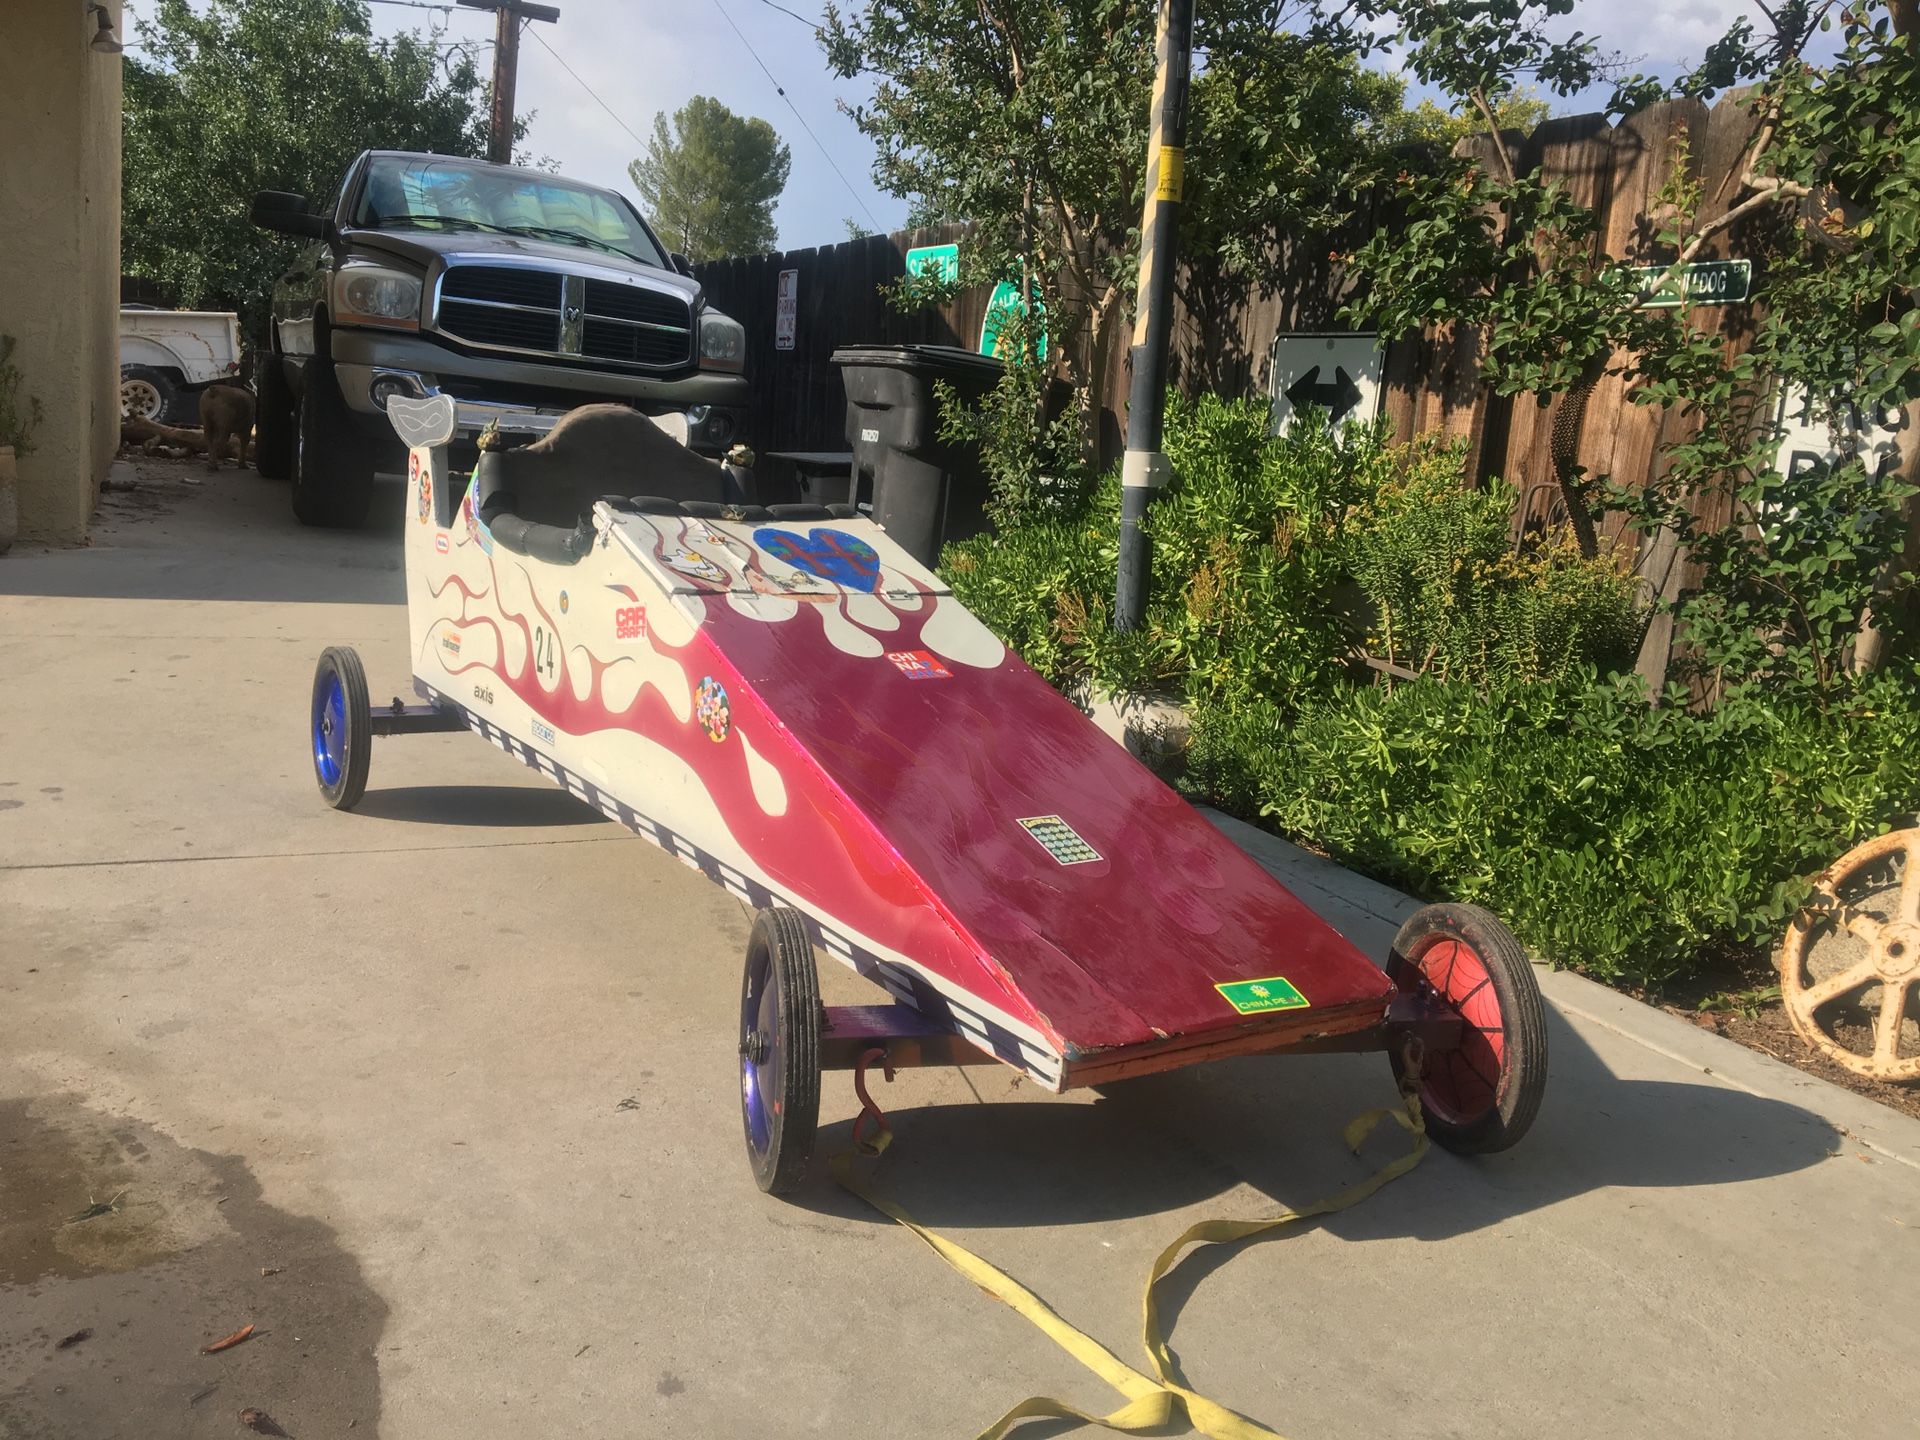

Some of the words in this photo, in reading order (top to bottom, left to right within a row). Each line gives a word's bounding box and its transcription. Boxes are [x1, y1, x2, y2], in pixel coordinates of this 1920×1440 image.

[1734, 264, 1748, 273] DR
[616, 606, 646, 626] CAR
[617, 625, 646, 639] CRAFT
[536, 626, 554, 679] 24
[474, 685, 494, 705] axis
